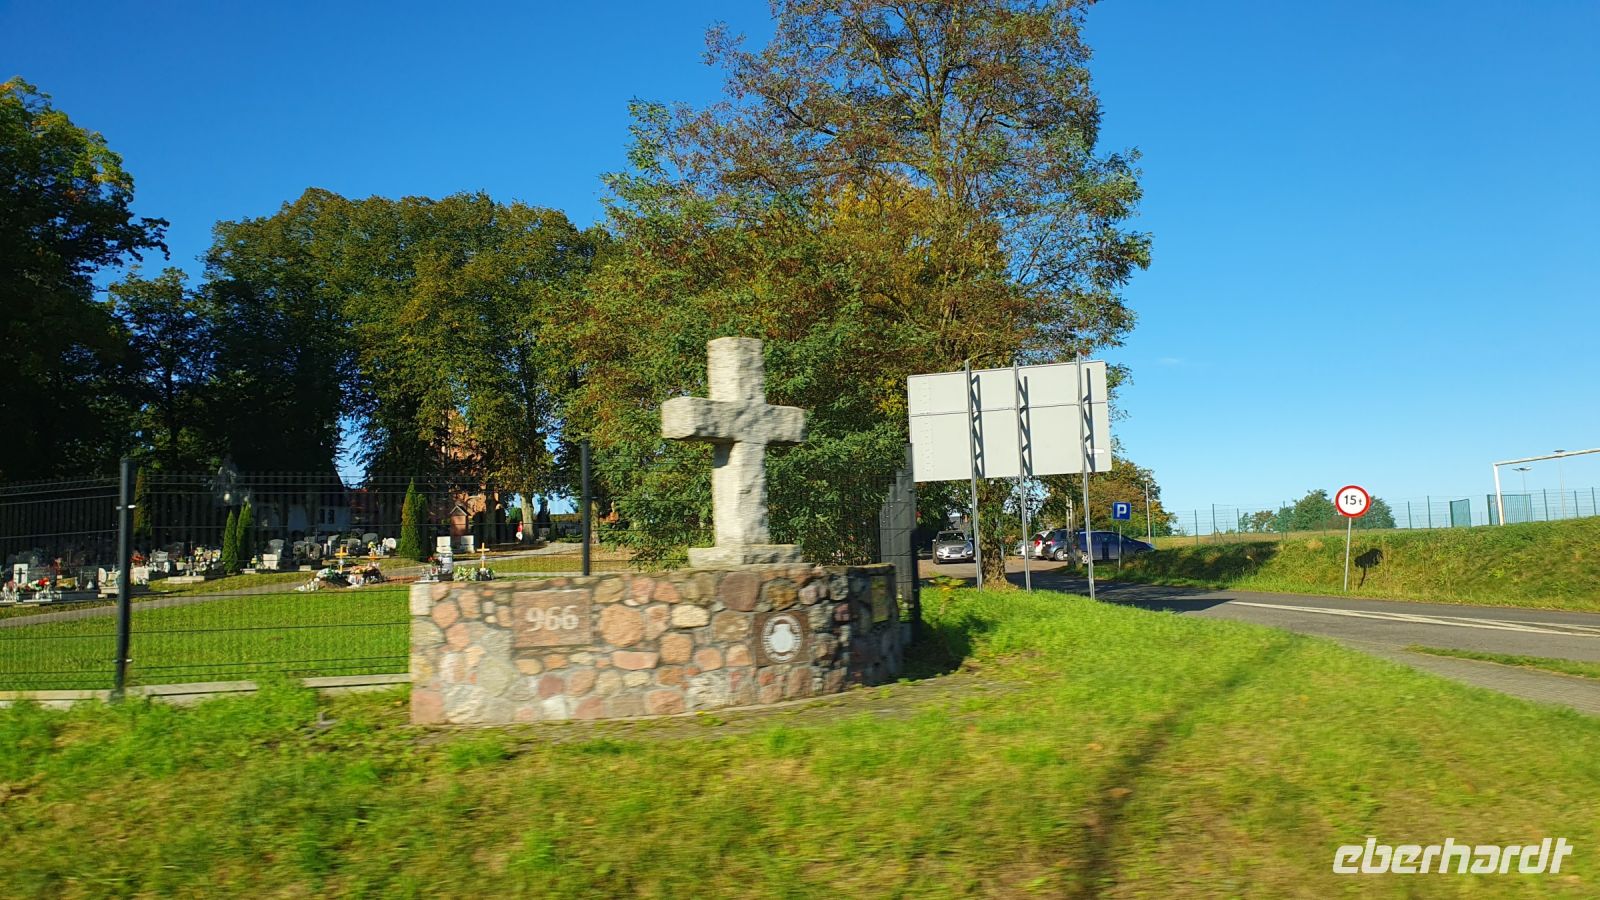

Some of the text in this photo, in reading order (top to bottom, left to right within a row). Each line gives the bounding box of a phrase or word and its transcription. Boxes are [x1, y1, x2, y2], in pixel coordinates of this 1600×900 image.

[1344, 494, 1357, 506] 15
[1116, 504, 1127, 518] P
[525, 605, 579, 632] 966
